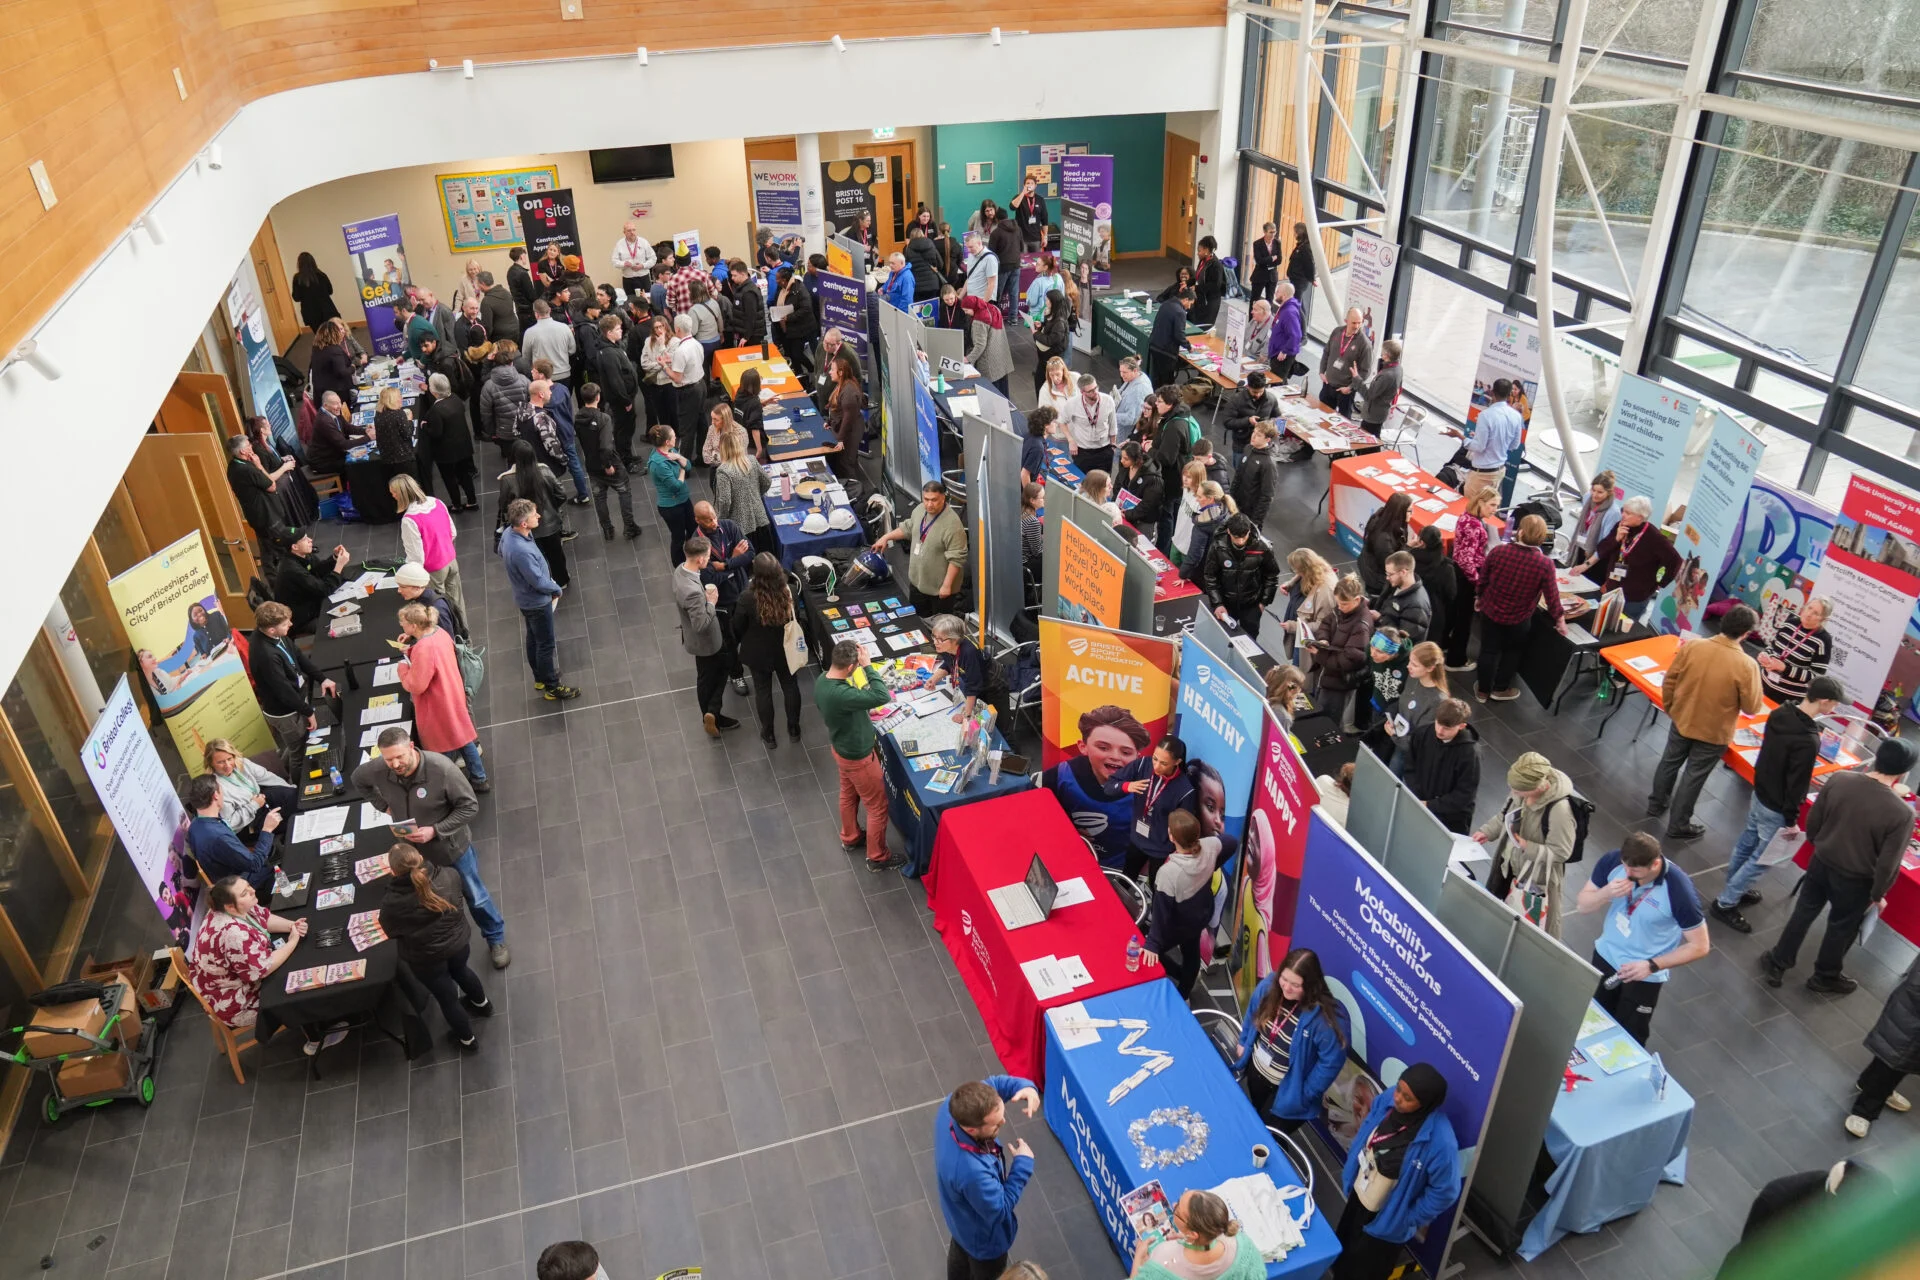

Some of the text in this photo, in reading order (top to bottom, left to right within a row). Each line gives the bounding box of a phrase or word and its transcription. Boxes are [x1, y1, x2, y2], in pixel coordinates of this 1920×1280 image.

[523, 198, 543, 210] on
[836, 189, 864, 197] BRISTOL
[836, 197, 854, 205] POST
[545, 204, 571, 218] site
[347, 227, 387, 240] CONVERSATION
[348, 238, 365, 246] CLUBS
[536, 235, 569, 244] Construction
[1072, 223, 1082, 234] FREE
[1083, 227, 1092, 238] help
[350, 243, 371, 252] BRISTOL
[362, 282, 392, 300] Get
[823, 280, 858, 296] centregreat
[826, 304, 857, 317] centregreat
[1105, 317, 1137, 346] YOUTH GUARANTEE
[1490, 343, 1518, 357] Education
[1499, 340, 1512, 349] Kind
[1621, 409, 1654, 428] Work with
[1623, 399, 1632, 408] Do
[1633, 403, 1668, 423] something
[1668, 418, 1680, 428] BIG
[1618, 419, 1664, 442] small children
[1720, 444, 1740, 467] something
[1718, 468, 1735, 487] children
[1852, 480, 1871, 494] Think
[1872, 488, 1907, 510] University
[1908, 504, 1914, 512] is
[1884, 504, 1901, 516] You?
[1865, 509, 1913, 536] THINK AGAIN!
[170, 541, 199, 562] Bristol College
[1065, 545, 1100, 579] travel to
[1066, 530, 1116, 577] Helping you
[1065, 560, 1103, 597] your new
[1825, 561, 1906, 604] Hartcliffe Micro-Campus
[125, 567, 198, 616] Apprenticeships at
[129, 572, 210, 627] City of Bristol College
[1065, 574, 1105, 615] workplace
[1829, 618, 1848, 630] artners
[1090, 642, 1128, 653] BRISTOL
[1090, 648, 1120, 656] SPORT
[1090, 653, 1143, 667] FOUNDATION
[1066, 664, 1144, 695] ACTIVE
[1211, 673, 1234, 694] BRISTOL
[1211, 680, 1230, 699] SPORT
[1210, 686, 1242, 718] FOUNDATION
[101, 698, 134, 754] Bristol College
[1184, 684, 1245, 753] HEALTHY
[105, 776, 115, 792] Over
[130, 730, 138, 742] the
[108, 774, 125, 802] following
[1279, 766, 1301, 807] FOUNDATION
[1264, 766, 1297, 836] HAPPY
[1355, 876, 1432, 963] Motability
[1360, 904, 1442, 996] Operations
[1332, 909, 1453, 1040] Delivering the Motability Scheme.
[1309, 895, 1480, 1082] The service that keeps disabled people moving
[1360, 982, 1405, 1033] www.mo.co.uk
